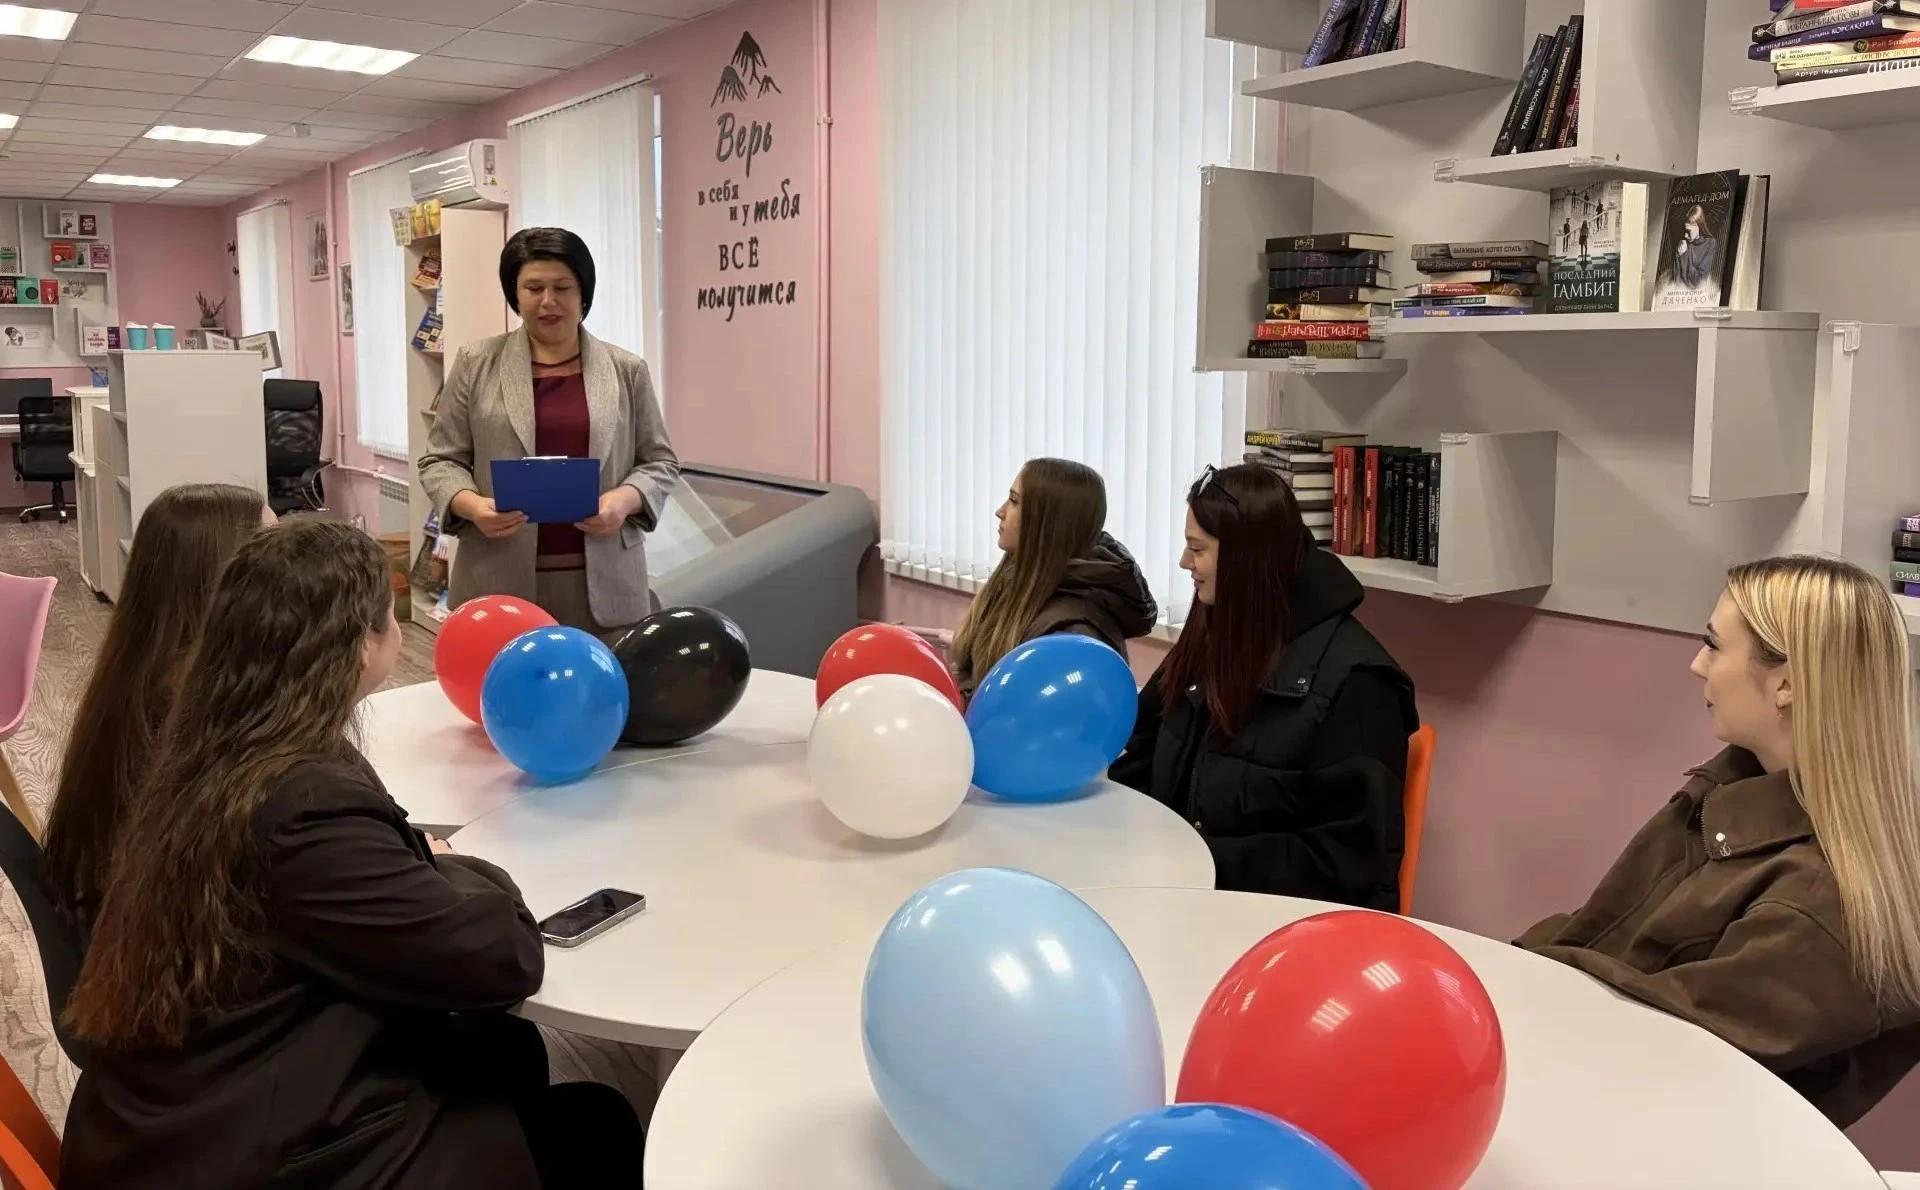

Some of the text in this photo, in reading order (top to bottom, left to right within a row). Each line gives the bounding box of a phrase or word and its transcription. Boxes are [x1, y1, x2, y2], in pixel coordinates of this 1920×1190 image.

[1831, 19, 1875, 35] КОРСАКОВА
[1888, 36, 1920, 47] Брэдбер
[1795, 69, 1819, 78] Артур
[1820, 67, 1849, 76] Гедеон
[1520, 67, 1549, 130] ДОЧЬ ЧАСОВЩИКА
[715, 112, 773, 178] Верь
[698, 179, 739, 206] в себя
[1671, 190, 1731, 205] АРМАГЕД-ДОМ
[729, 178, 801, 226] и у тебя
[718, 236, 760, 272] ВСЁ
[1553, 268, 1616, 281] ПОСЛЕДНИЙ
[1553, 281, 1616, 300] ГАМБИТ
[697, 280, 796, 322] получится
[1661, 295, 1707, 305] ДЯЧЕНКО
[1331, 324, 1362, 339] ТЕРРИ
